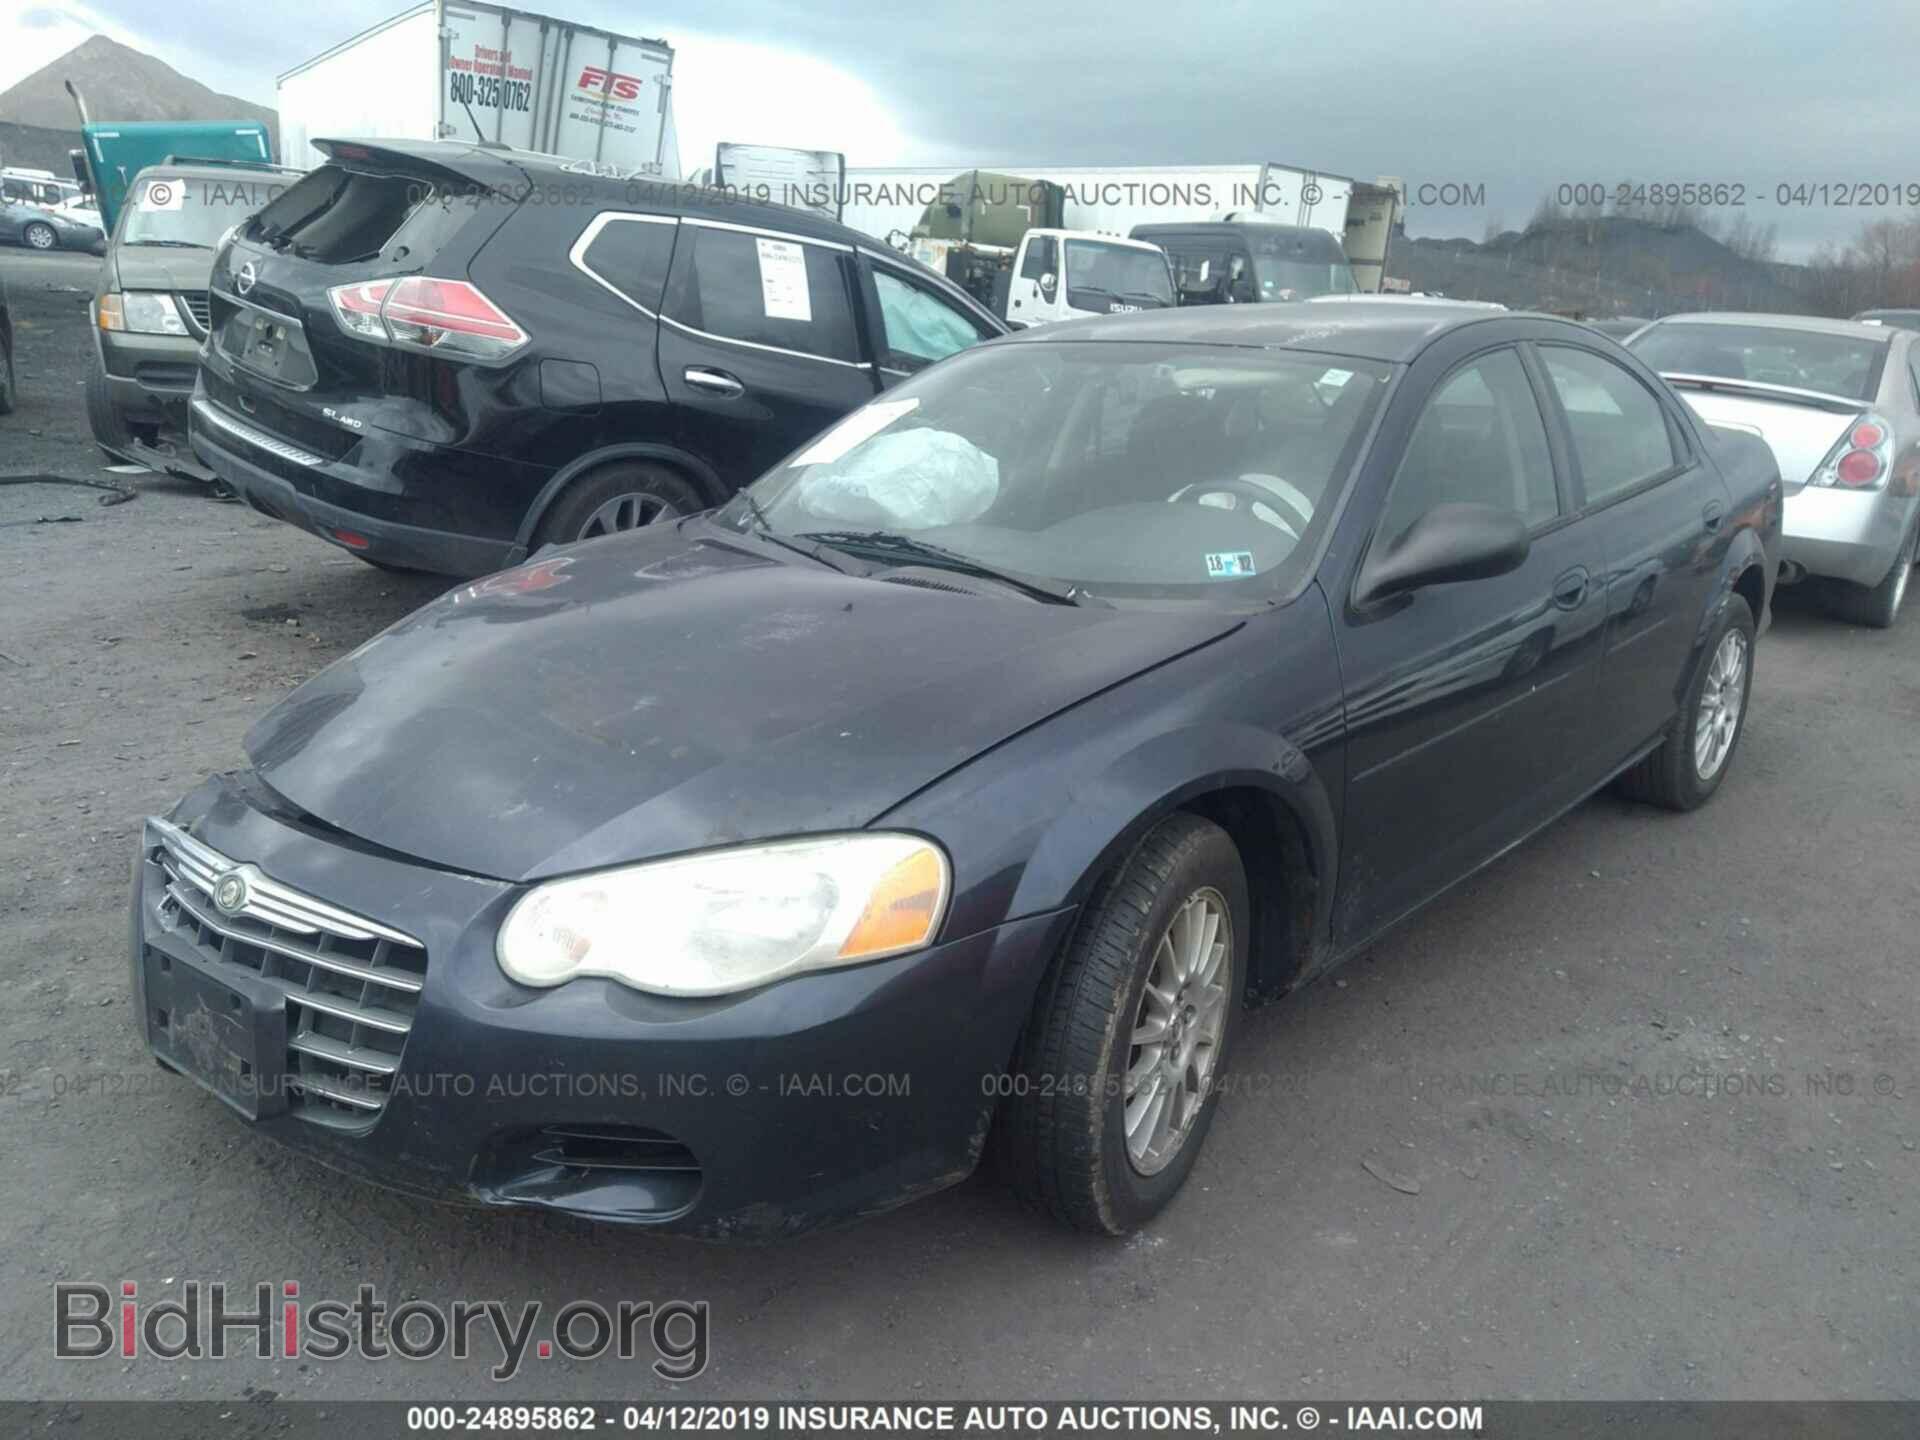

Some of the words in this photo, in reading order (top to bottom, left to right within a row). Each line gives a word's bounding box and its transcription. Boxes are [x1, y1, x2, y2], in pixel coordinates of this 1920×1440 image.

[474, 60, 506, 76] Operator
[578, 65, 643, 99] FTS
[340, 415, 362, 429] AWD
